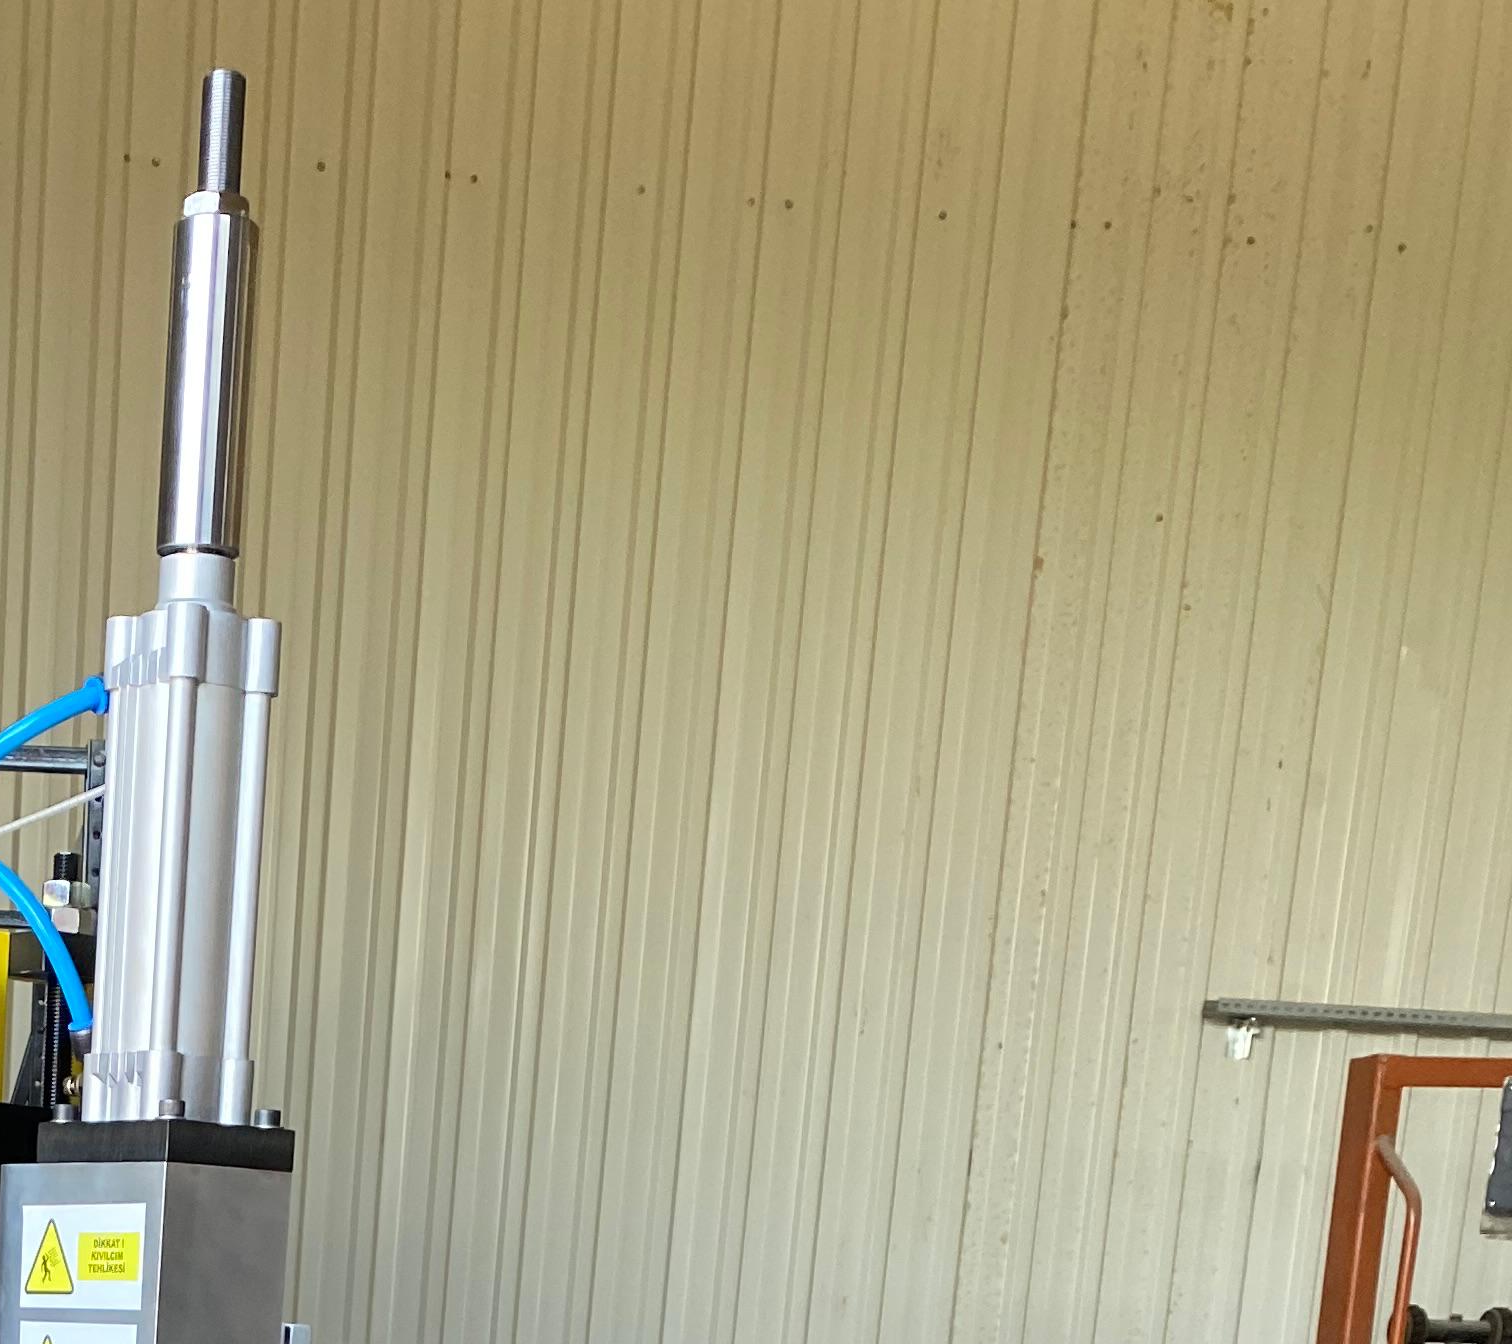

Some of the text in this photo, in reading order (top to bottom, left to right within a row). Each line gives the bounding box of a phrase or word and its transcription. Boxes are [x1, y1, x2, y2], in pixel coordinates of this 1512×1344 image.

[93, 1237, 120, 1248] DİKKAT
[90, 1251, 123, 1261] KIVILCIM
[88, 1262, 126, 1273] TEHLİKESİ
